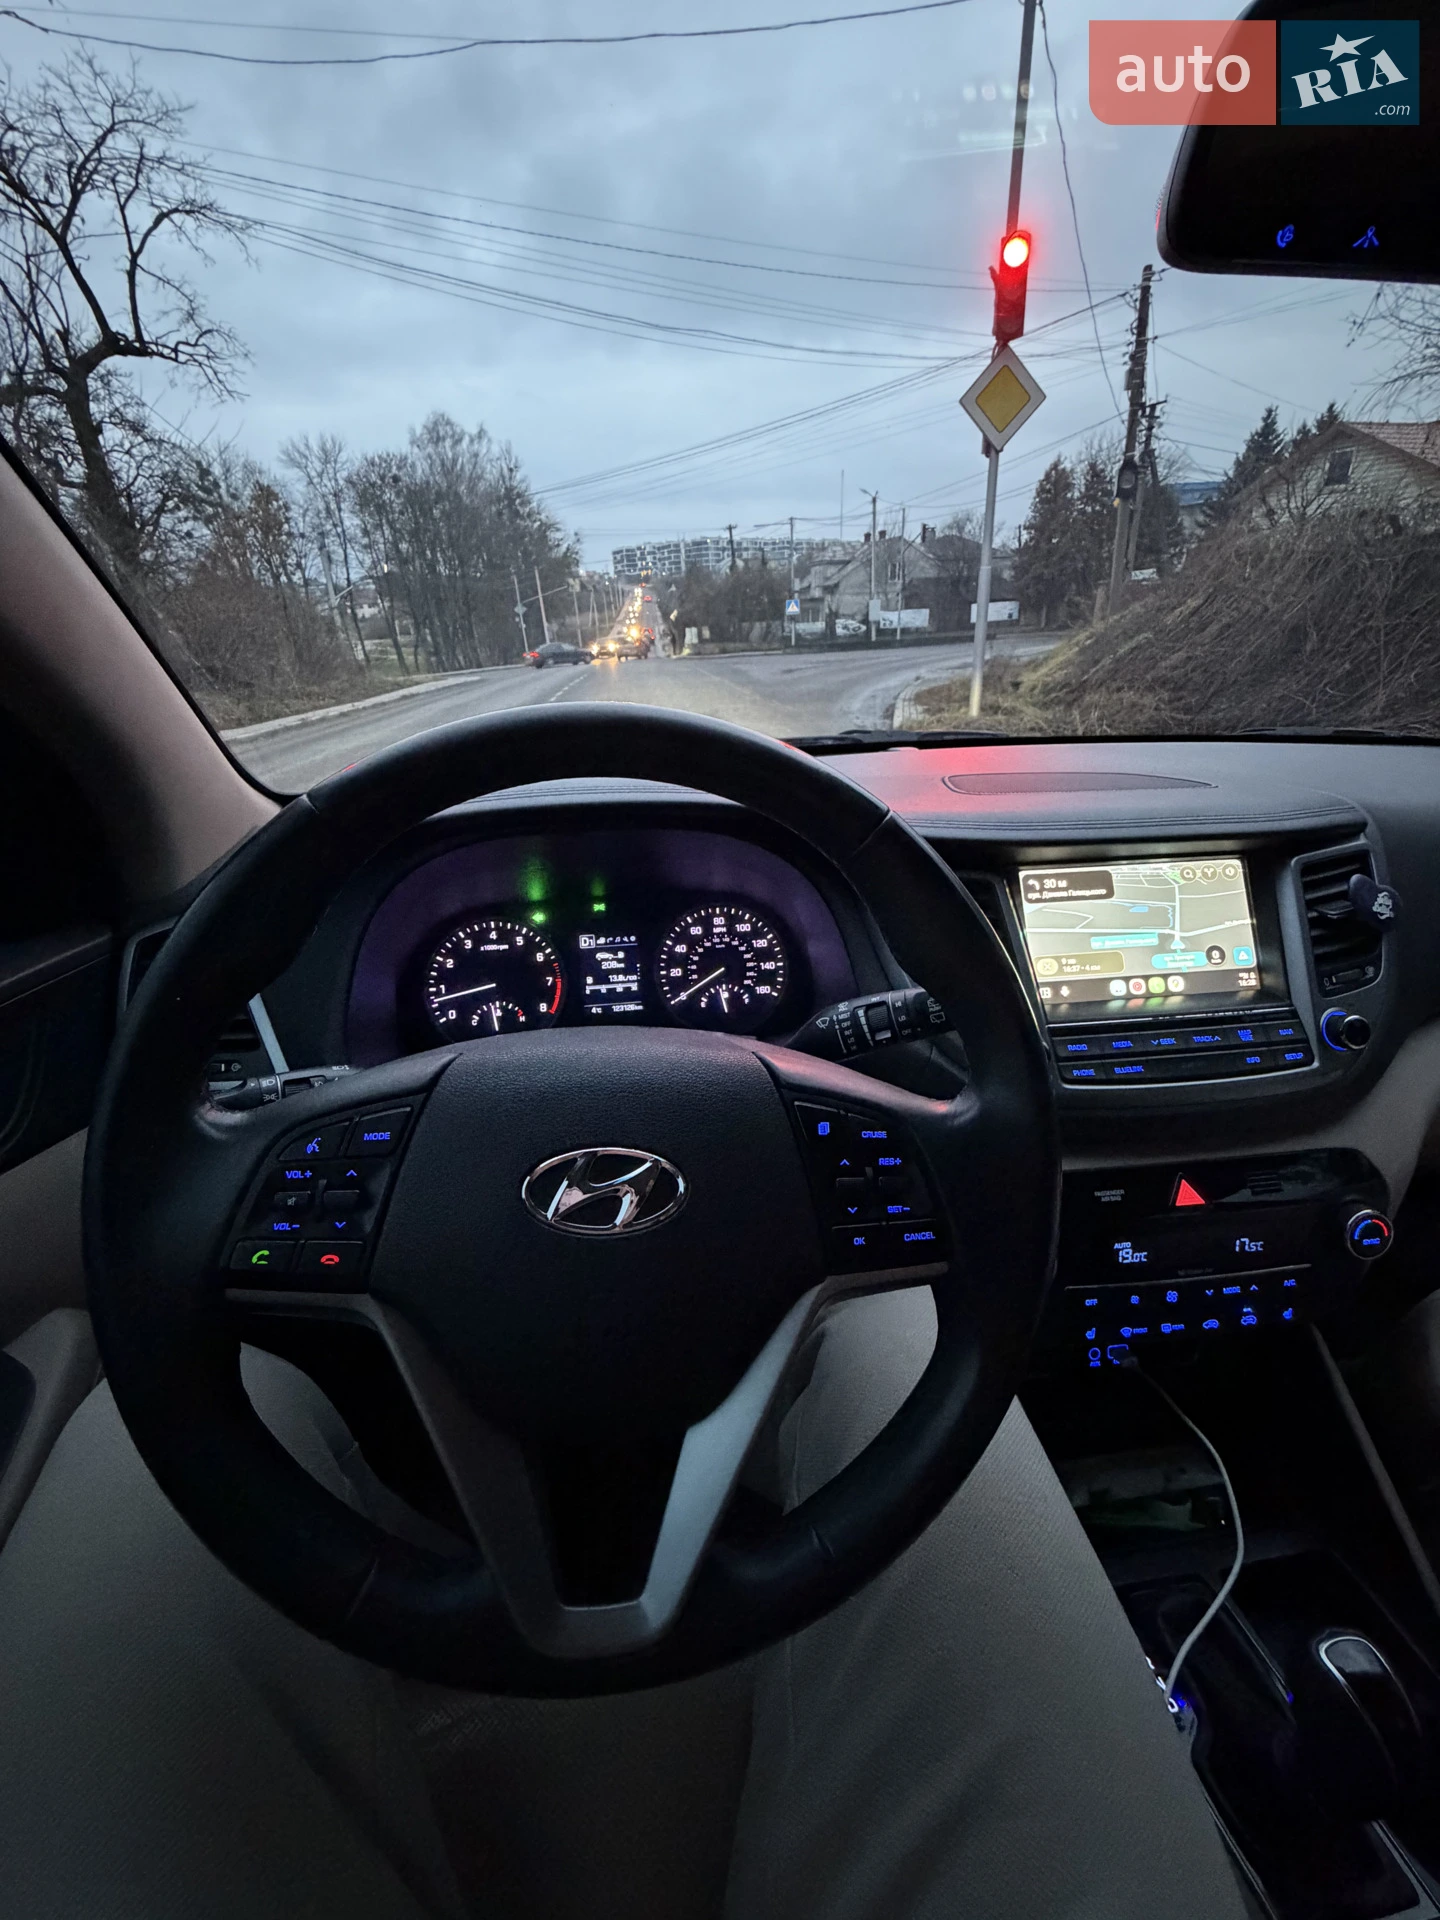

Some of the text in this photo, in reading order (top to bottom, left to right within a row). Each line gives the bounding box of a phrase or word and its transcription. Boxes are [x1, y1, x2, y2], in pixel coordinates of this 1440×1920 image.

[1043, 878, 1057, 889] 30
[713, 916, 725, 926] 80
[690, 926, 702, 935] 60
[712, 926, 727, 934] MPH
[735, 923, 751, 932] 100
[489, 930, 497, 940] 4
[464, 939, 472, 949] 3
[516, 936, 524, 946] 5
[752, 939, 768, 948] 120
[674, 944, 687, 953] 40
[536, 952, 544, 962] 6
[446, 958, 454, 968] 2
[760, 961, 776, 970] 140
[670, 968, 682, 977] 20
[545, 976, 553, 986] 7
[439, 984, 446, 994] 1
[755, 985, 771, 994] 160
[539, 1002, 548, 1012] 8
[448, 1009, 457, 1020] 0
[1112, 1040, 1133, 1049] MEDIA
[1072, 1069, 1096, 1077] PHONE
[363, 1131, 391, 1141] MODE
[878, 1157, 902, 1165] RES+
[285, 1170, 312, 1178] VOL+
[853, 1237, 866, 1245] OK
[904, 1232, 936, 1241] CANCEL
[1222, 1286, 1241, 1294] MODE
